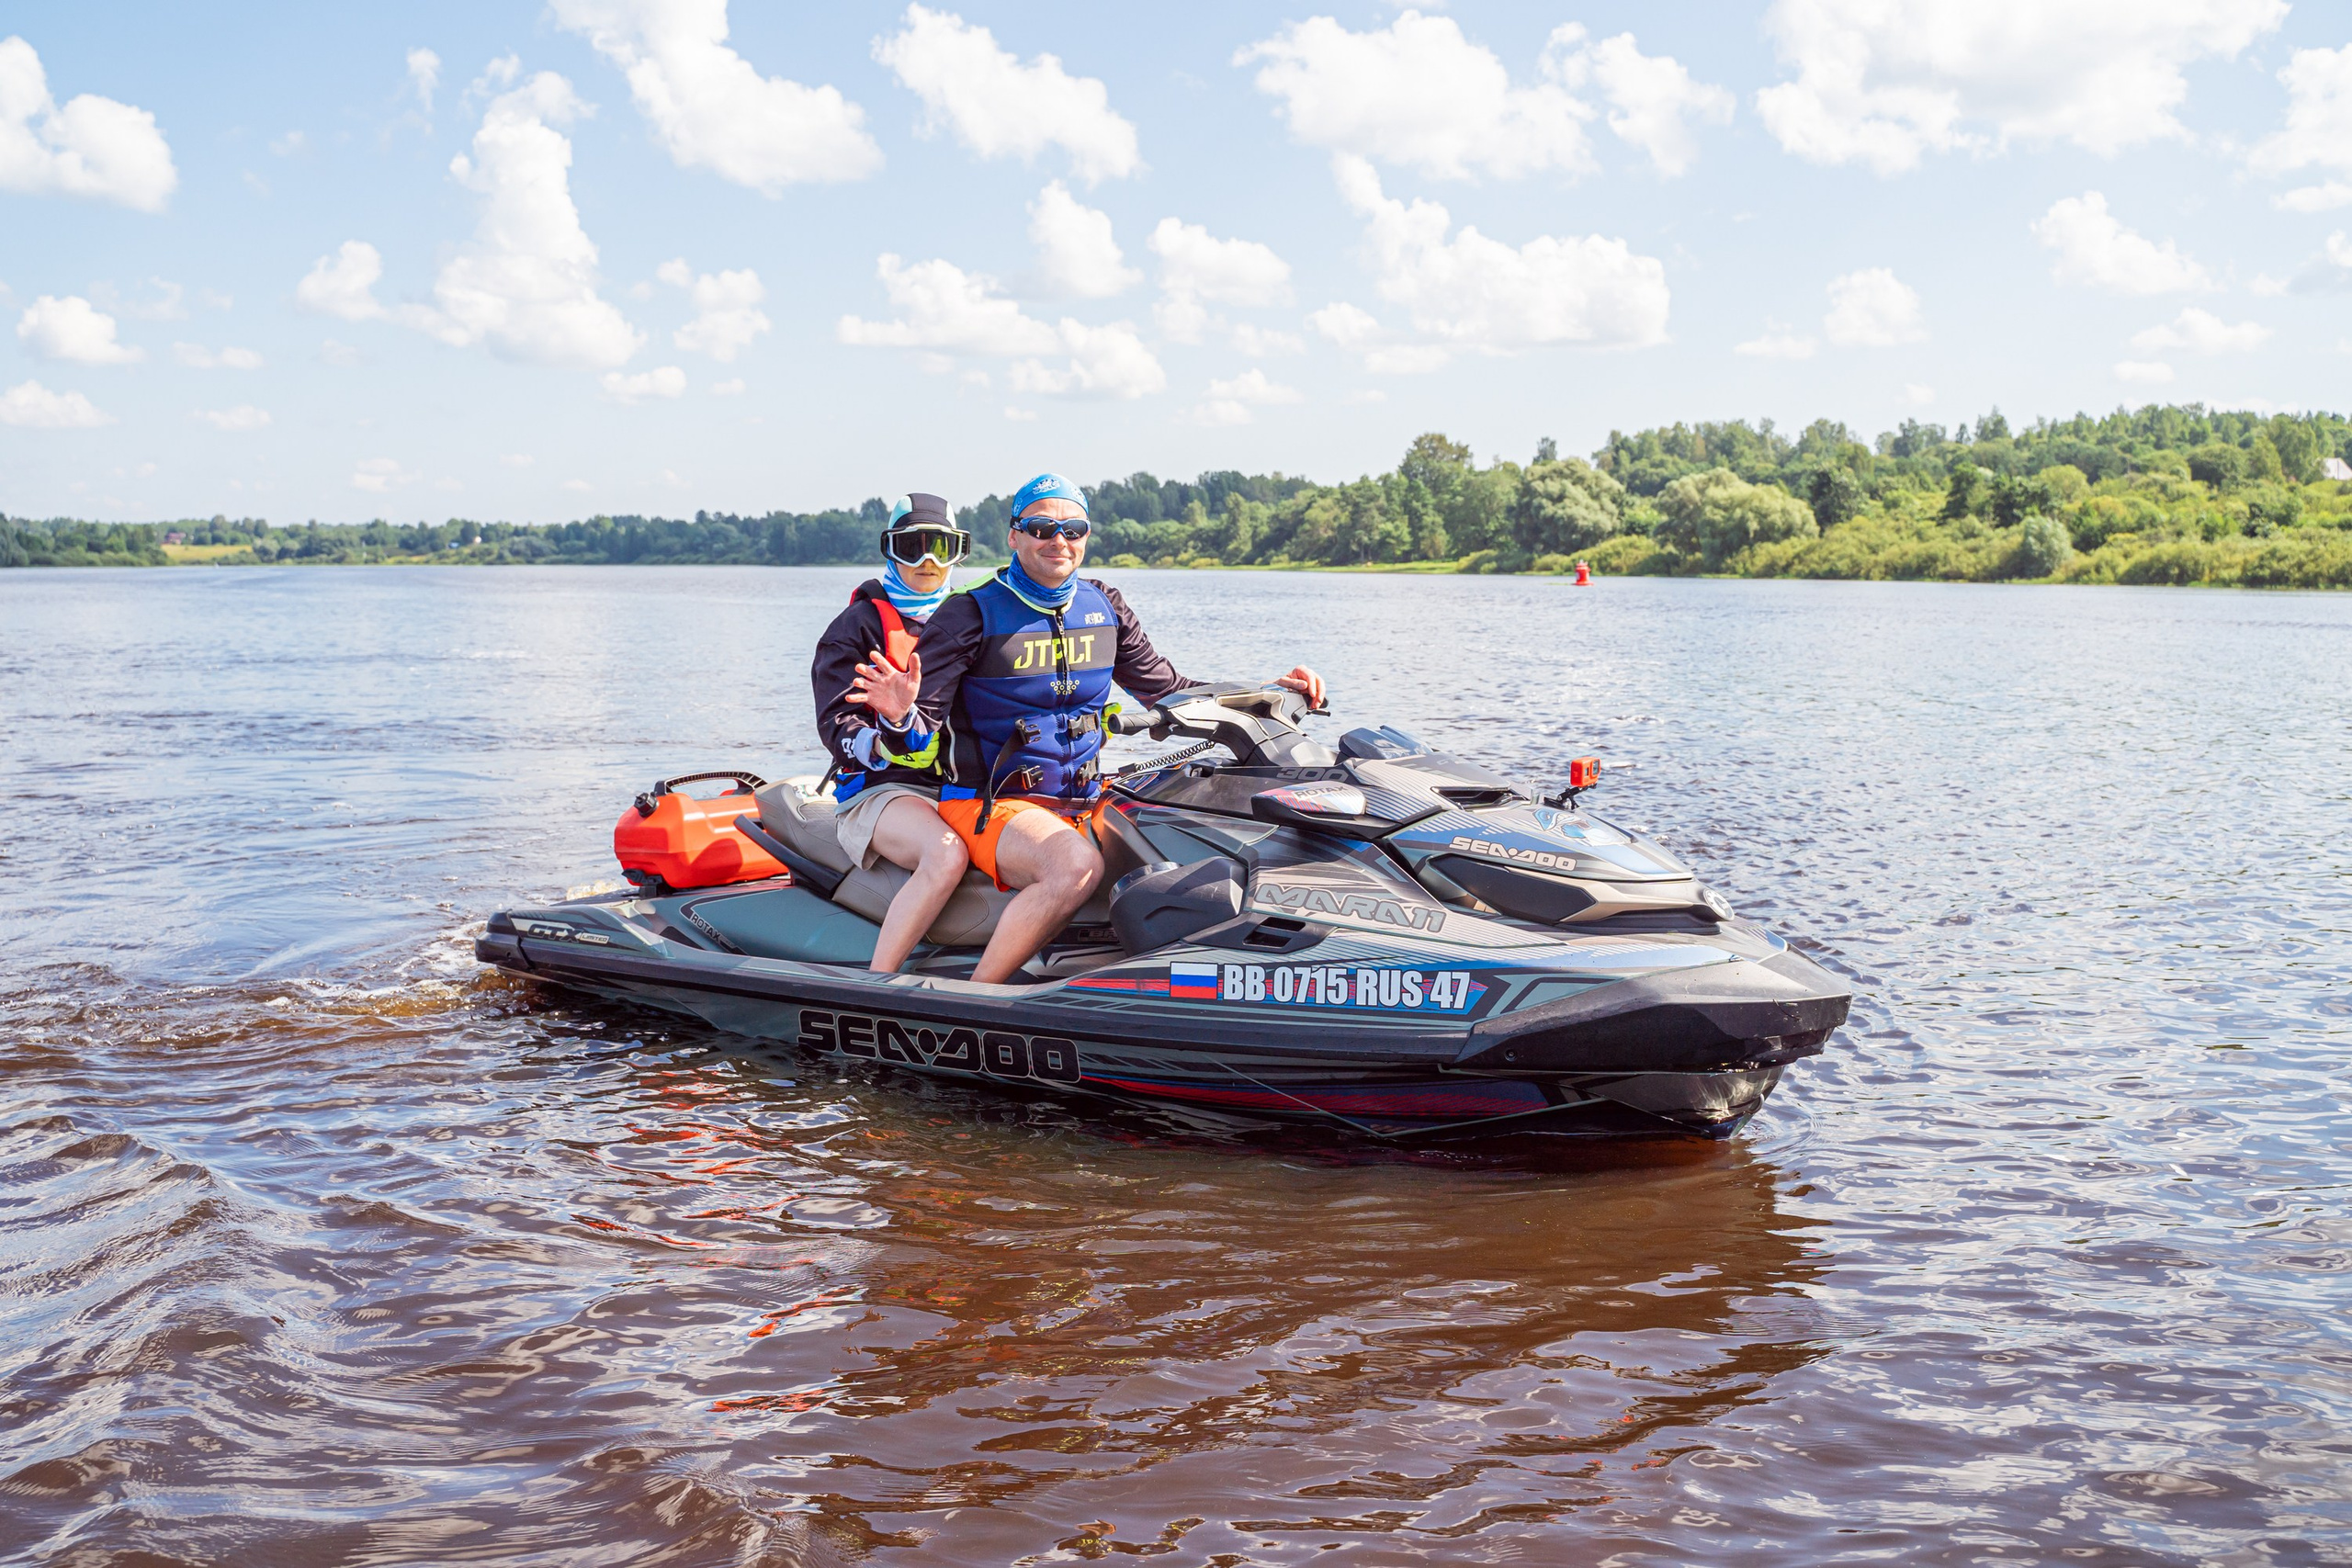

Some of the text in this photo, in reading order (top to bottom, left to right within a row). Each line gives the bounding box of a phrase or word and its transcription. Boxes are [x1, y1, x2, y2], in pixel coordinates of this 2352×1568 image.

[1013, 635, 1094, 669] JTPLT
[1276, 767, 1349, 782] 300
[1294, 785, 1348, 799] ROTAX
[528, 923, 608, 942] GTX LIMITED
[691, 913, 721, 943] ROTAX
[1223, 964, 1470, 1010] BB 0715 RUS 47
